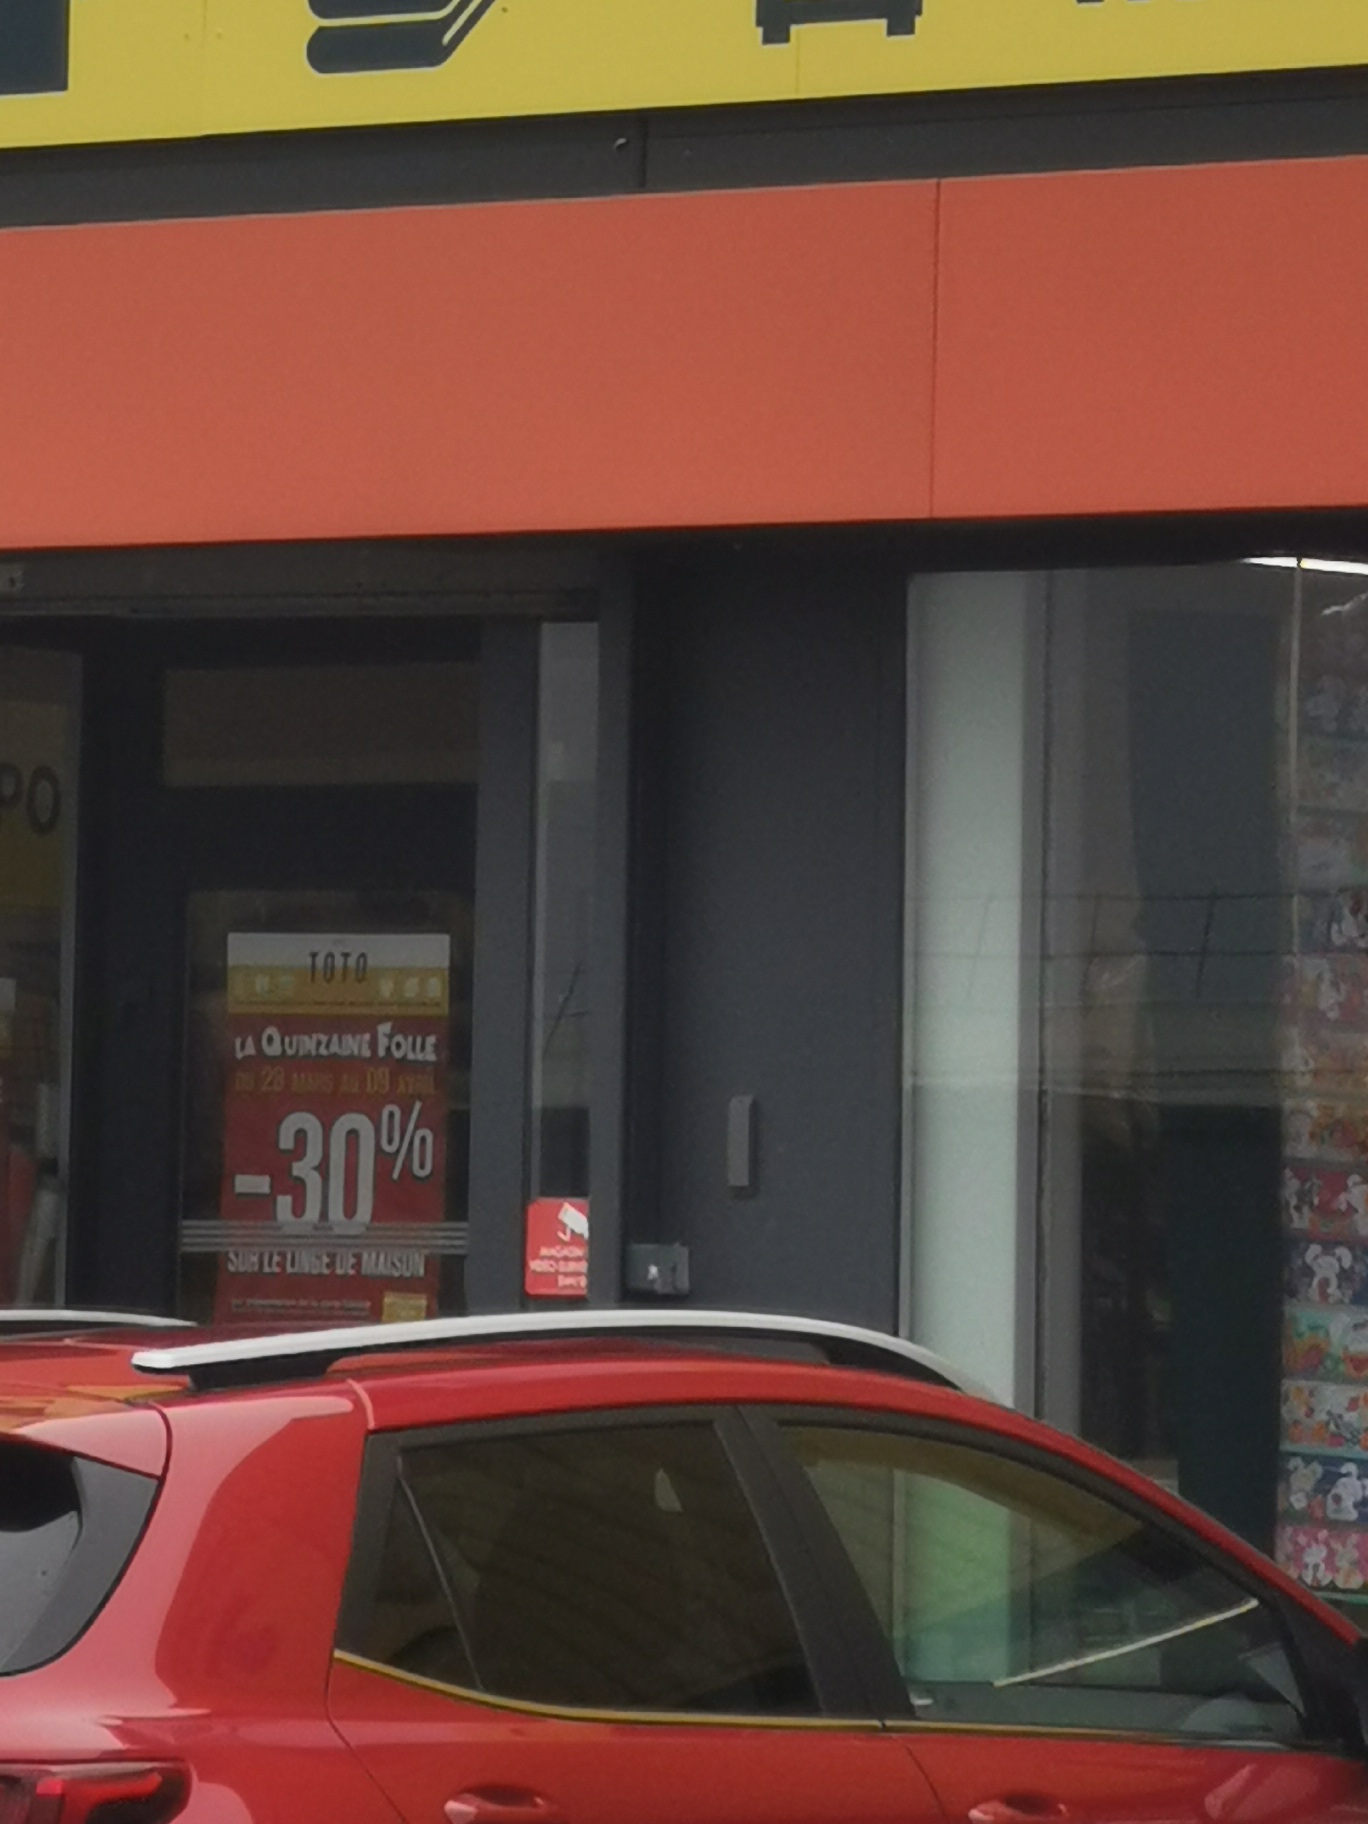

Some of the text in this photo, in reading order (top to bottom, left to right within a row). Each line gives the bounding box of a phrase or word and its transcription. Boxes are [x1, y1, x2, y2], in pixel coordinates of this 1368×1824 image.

[308, 951, 369, 985] TOTO
[234, 1021, 437, 1063] LA QUINZAINE FOLLE
